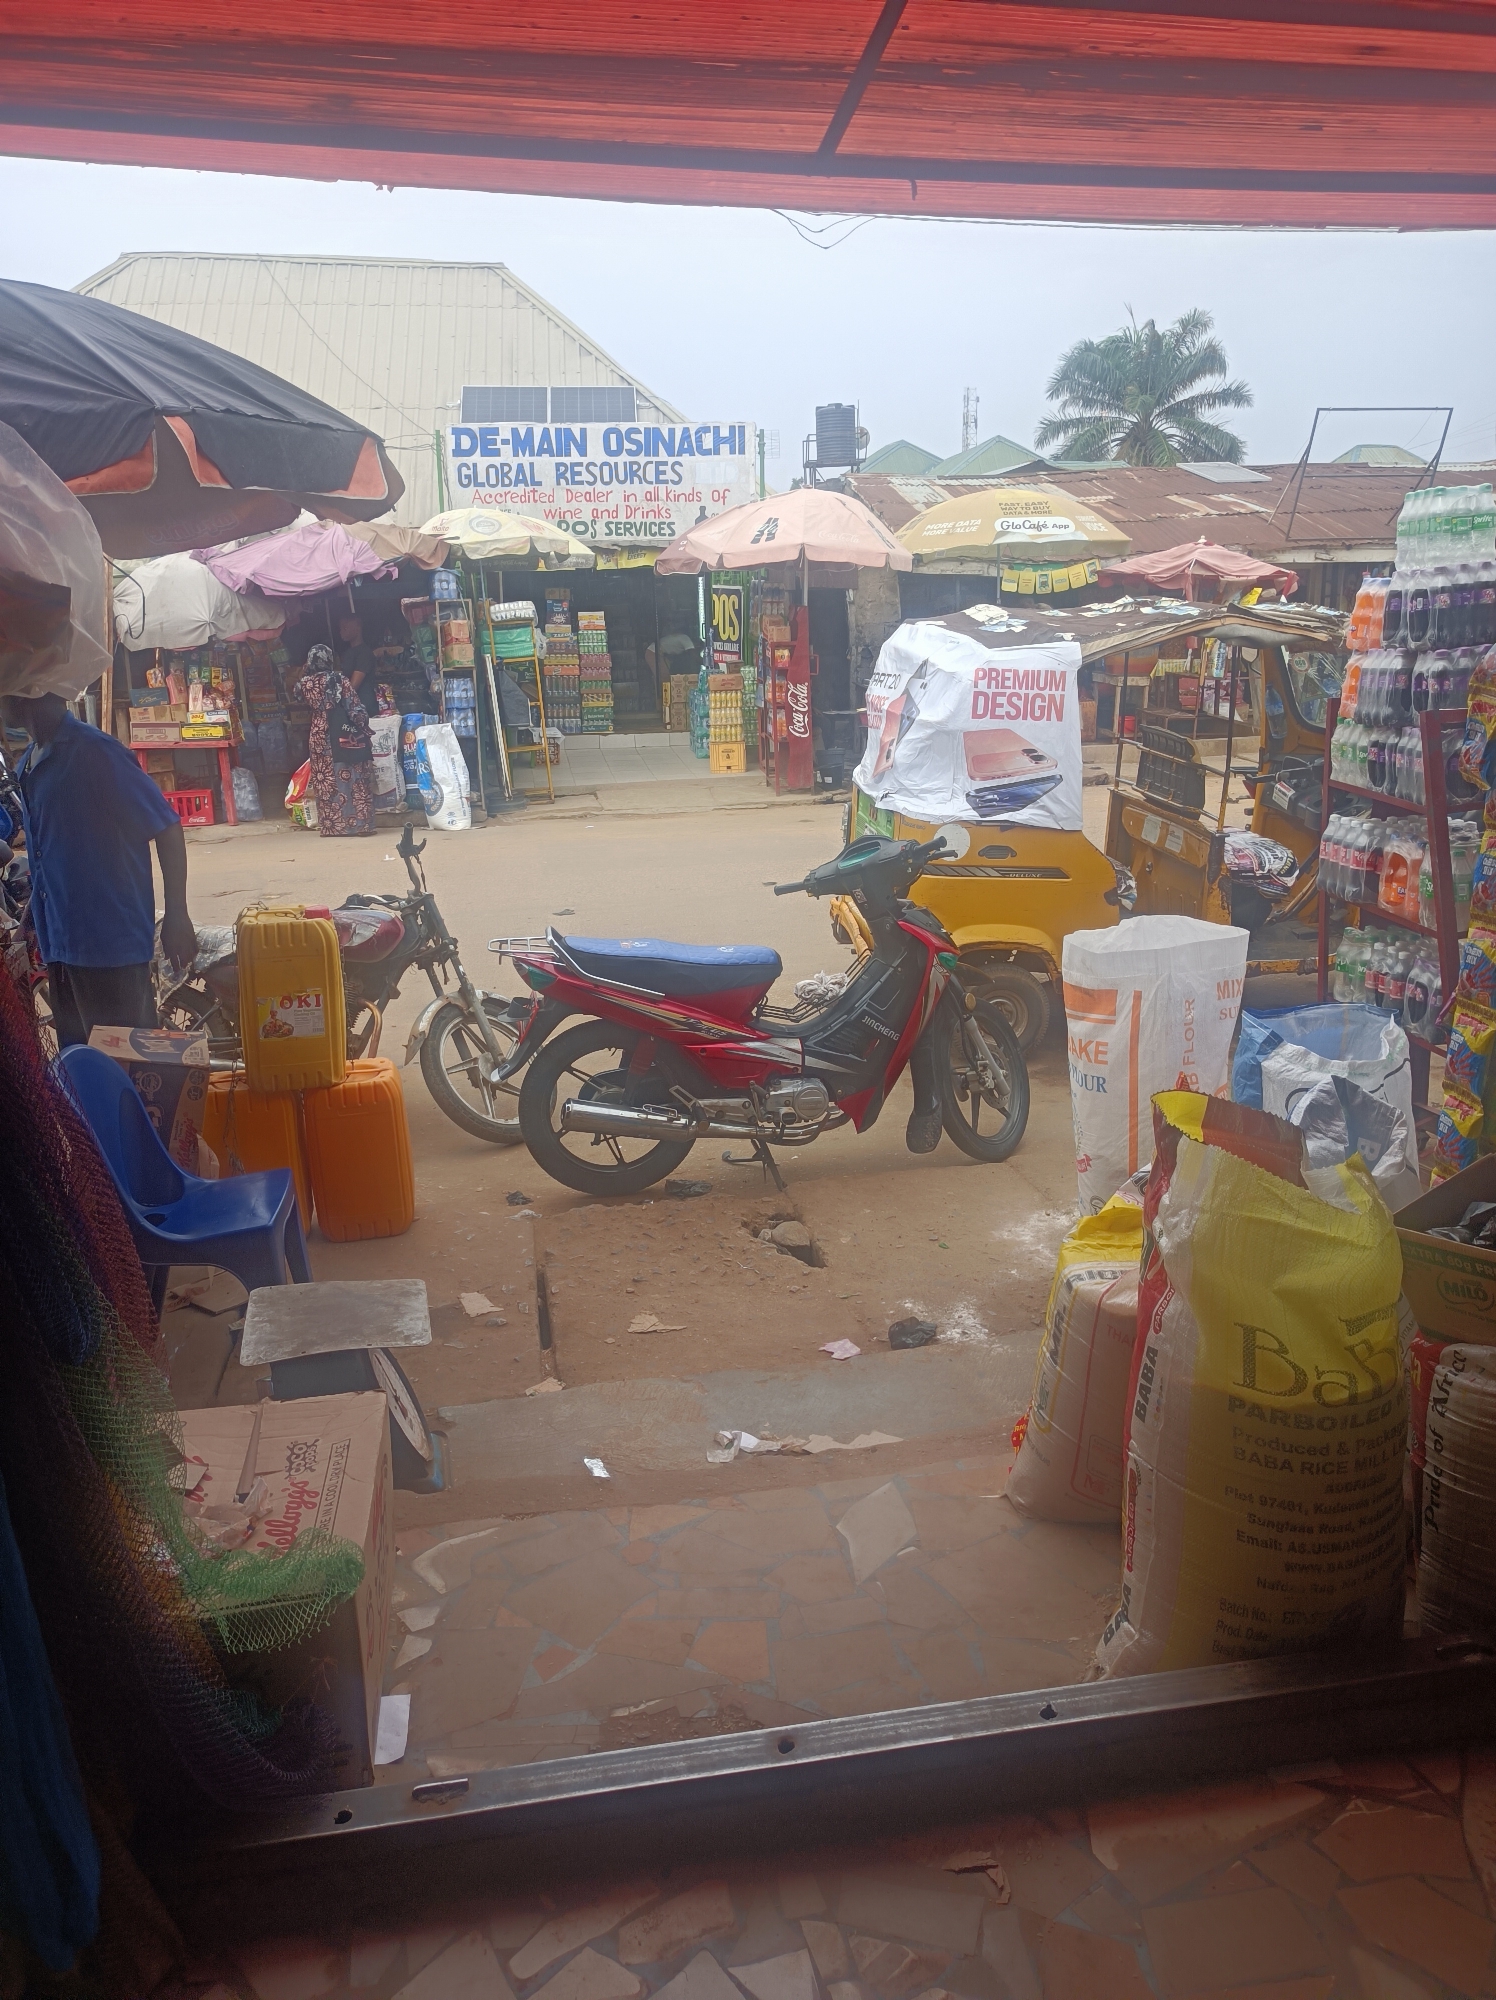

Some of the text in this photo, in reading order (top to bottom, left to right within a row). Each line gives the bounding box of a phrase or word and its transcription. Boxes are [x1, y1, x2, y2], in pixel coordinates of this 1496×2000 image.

[451, 425, 746, 457] DE-MAIN OSINACHI
[457, 462, 543, 489] GLOBAL
[555, 461, 683, 486] RESOURCES
[472, 488, 555, 504] Accredited
[566, 487, 613, 504] Dealer
[623, 490, 637, 502] in
[644, 486, 659, 502] all
[666, 486, 702, 502] kinds
[543, 504, 671, 519] wine and Drinks
[1473, 515, 1493, 524] Sprite
[557, 519, 676, 539] POS SERVICES
[921, 525, 980, 537] MORE VALUE
[924, 518, 982, 530] MORE DATA
[973, 668, 1067, 692] PREMIUM
[971, 690, 1066, 722] DESIGN
[280, 992, 322, 1010] OKI
[861, 1015, 900, 1041] JINCHENG
[1182, 998, 1196, 1067] FLOUR
[1443, 1280, 1489, 1302] MILO
[1154, 1286, 1176, 1330] PARBOI
[1134, 1345, 1159, 1424] BABA
[1232, 1425, 1332, 1457] Produced
[1337, 1439, 1351, 1456] &
[1428, 1424, 1444, 1451] of
[333, 1443, 347, 1467] PLACE
[1233, 1446, 1294, 1474] BABA
[1301, 1459, 1349, 1475] RICE
[330, 1467, 341, 1482] DRY
[325, 1481, 338, 1501] COOL
[1424, 1467, 1444, 1534] Pride
[322, 1508, 333, 1517] IN
